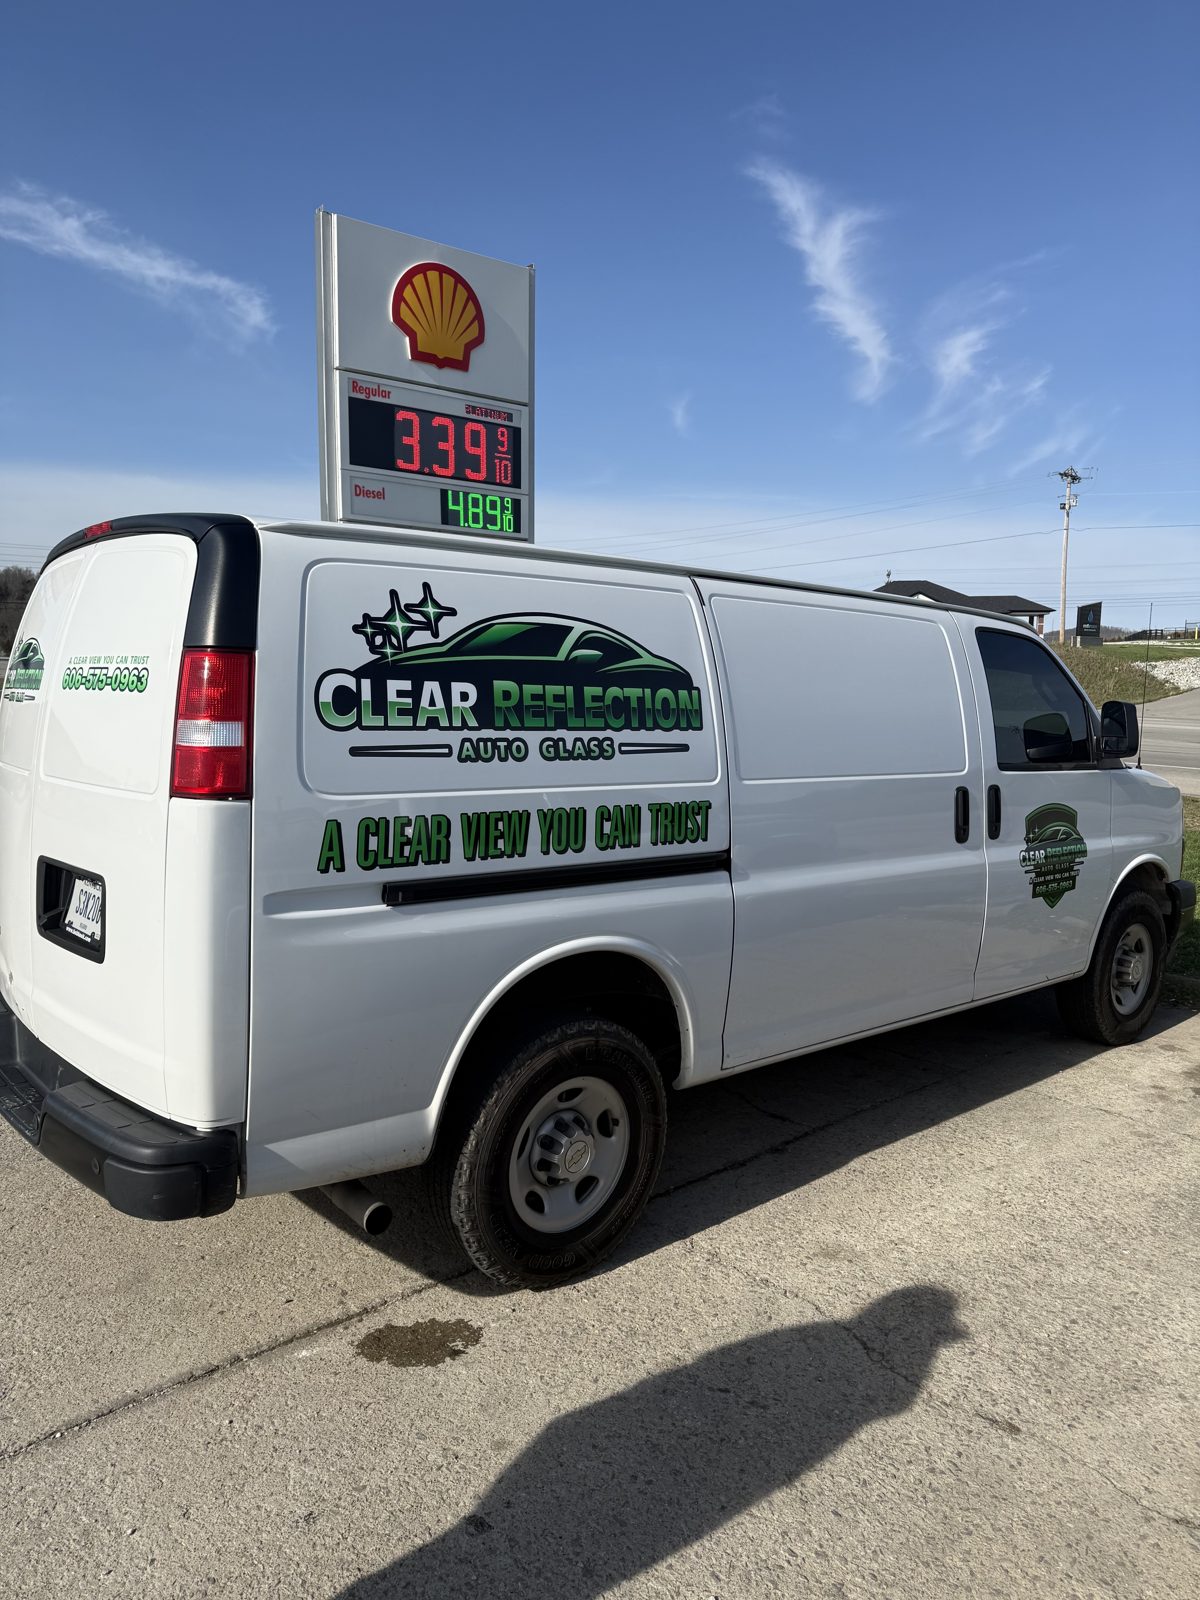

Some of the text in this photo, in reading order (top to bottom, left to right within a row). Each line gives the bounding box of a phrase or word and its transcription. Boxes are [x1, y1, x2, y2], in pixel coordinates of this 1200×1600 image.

[352, 380, 392, 400] Regular
[464, 404, 508, 422] PLATINUM
[395, 410, 487, 481] 3.39
[354, 485, 385, 500] Diesel
[448, 490, 501, 531] 4.89
[73, 656, 88, 665] CLEAR
[89, 656, 103, 665] VIEW
[103, 656, 115, 665] YOU
[115, 655, 129, 665] CAN
[130, 655, 150, 665] TRUST
[62, 667, 149, 693] 606-575-0963
[318, 673, 701, 729] CLEAR REFLECTION
[459, 738, 614, 761] AUTO GLASS
[317, 800, 711, 873] A CLEAR VIEW YOU CAN TRUST
[1020, 850, 1046, 866] CLEAR
